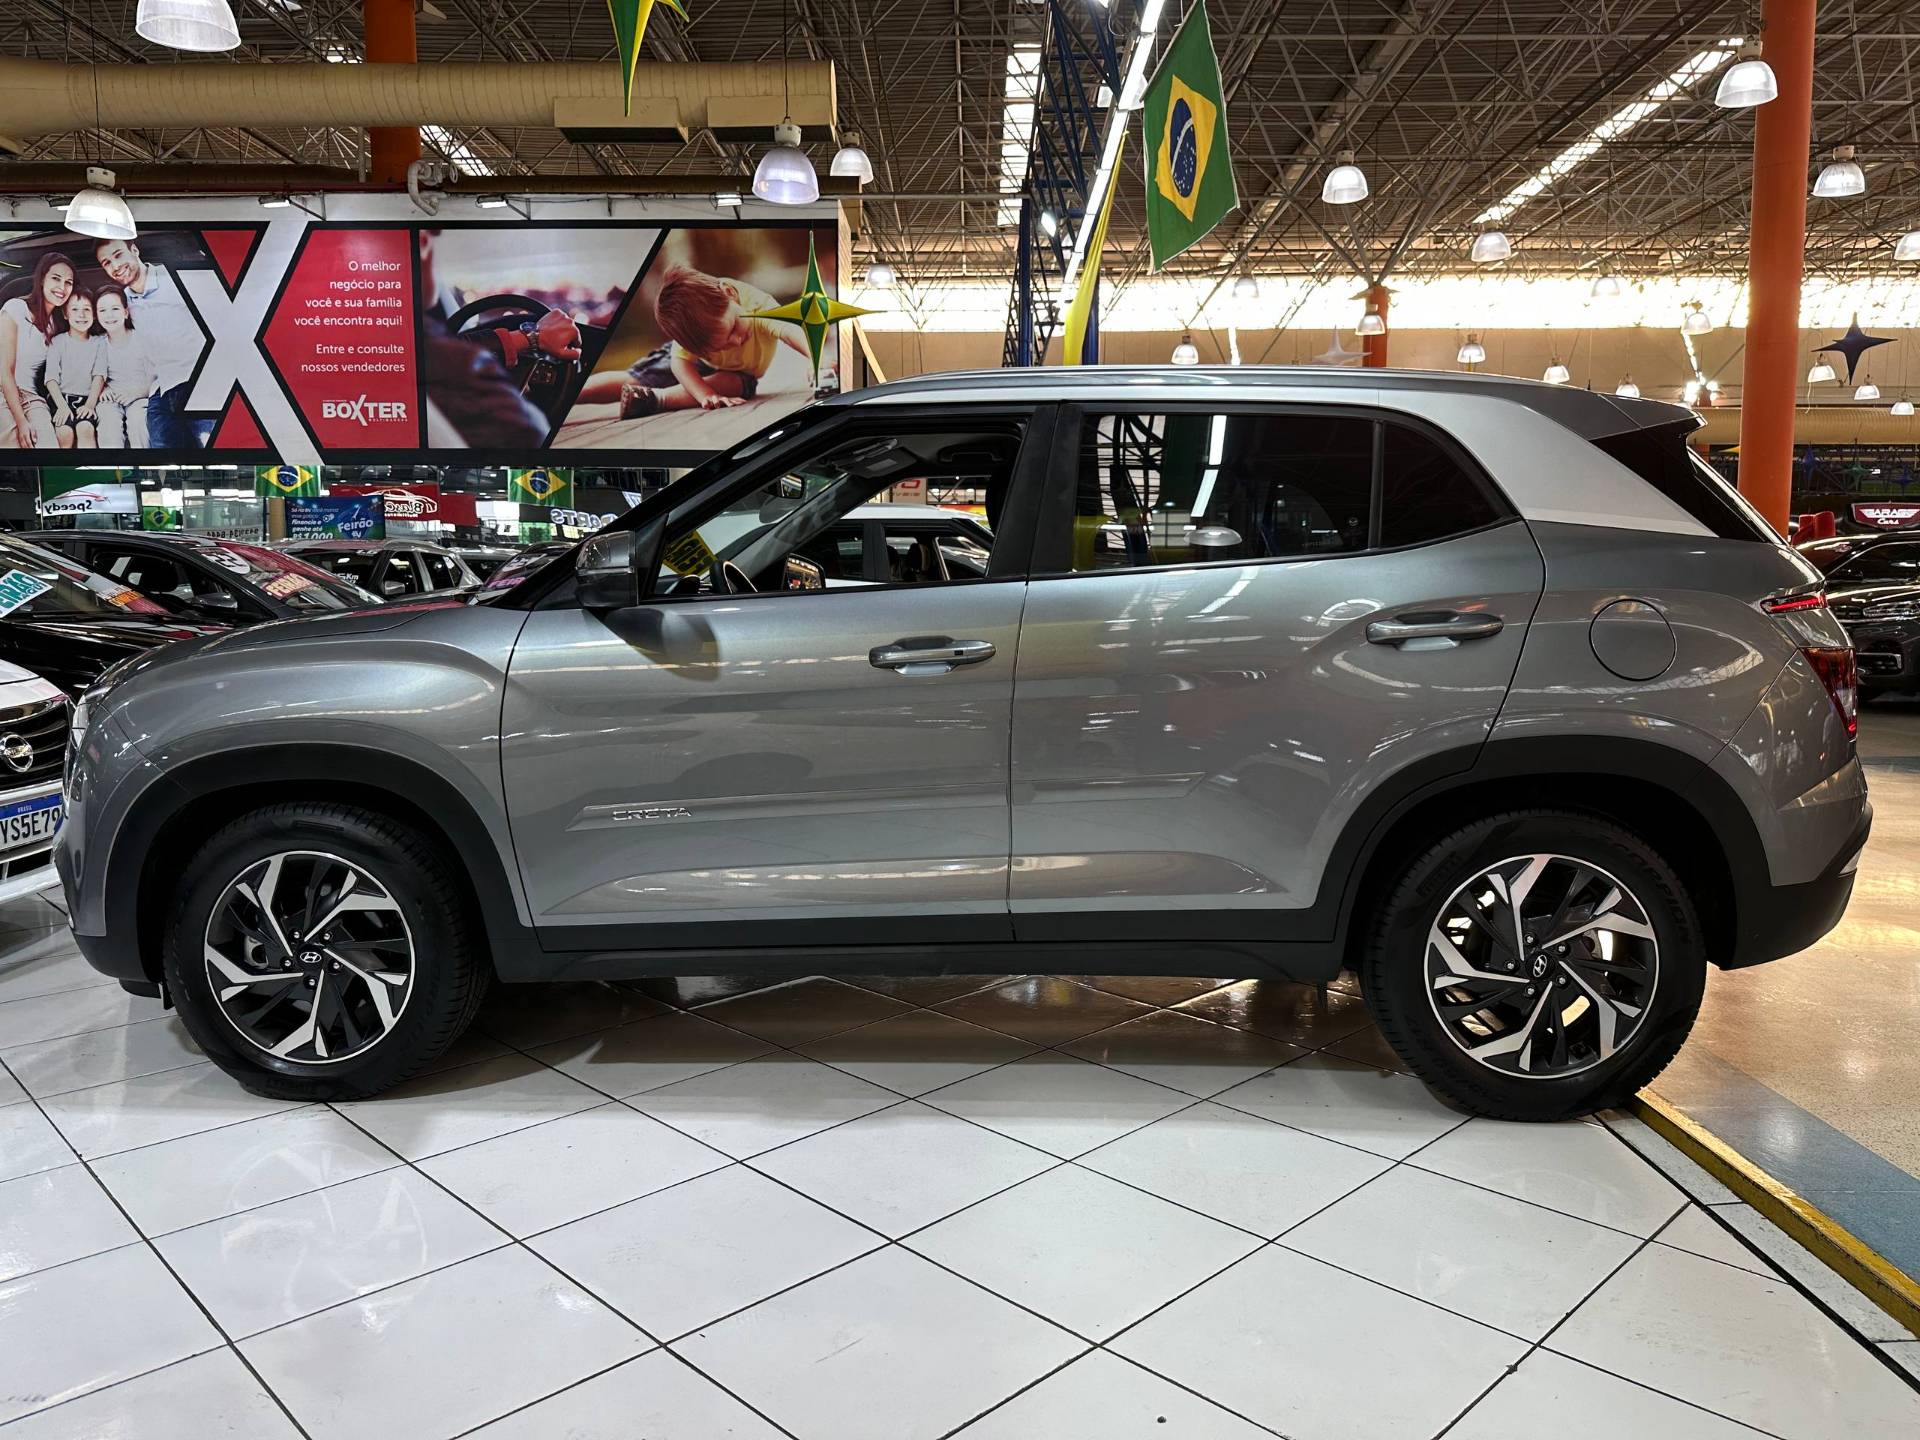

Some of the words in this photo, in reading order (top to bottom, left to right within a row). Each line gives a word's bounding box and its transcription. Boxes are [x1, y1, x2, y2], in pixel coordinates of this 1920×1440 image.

[348, 260, 359, 271] O
[361, 260, 401, 271] melhor
[329, 279, 375, 291] negócio
[377, 281, 401, 291] para
[305, 297, 332, 307] você
[366, 297, 402, 307] família
[294, 316, 321, 326] você
[323, 316, 373, 326] encontra
[375, 315, 402, 327] aqui!
[316, 343, 345, 354] Entre
[347, 346, 354, 354] e
[357, 343, 404, 354] consulte
[301, 363, 339, 372] nossos
[341, 362, 405, 372] vendedores
[322, 394, 407, 426] BOXTER
[337, 517, 374, 533] Feirão
[612, 807, 692, 821] CRETA
